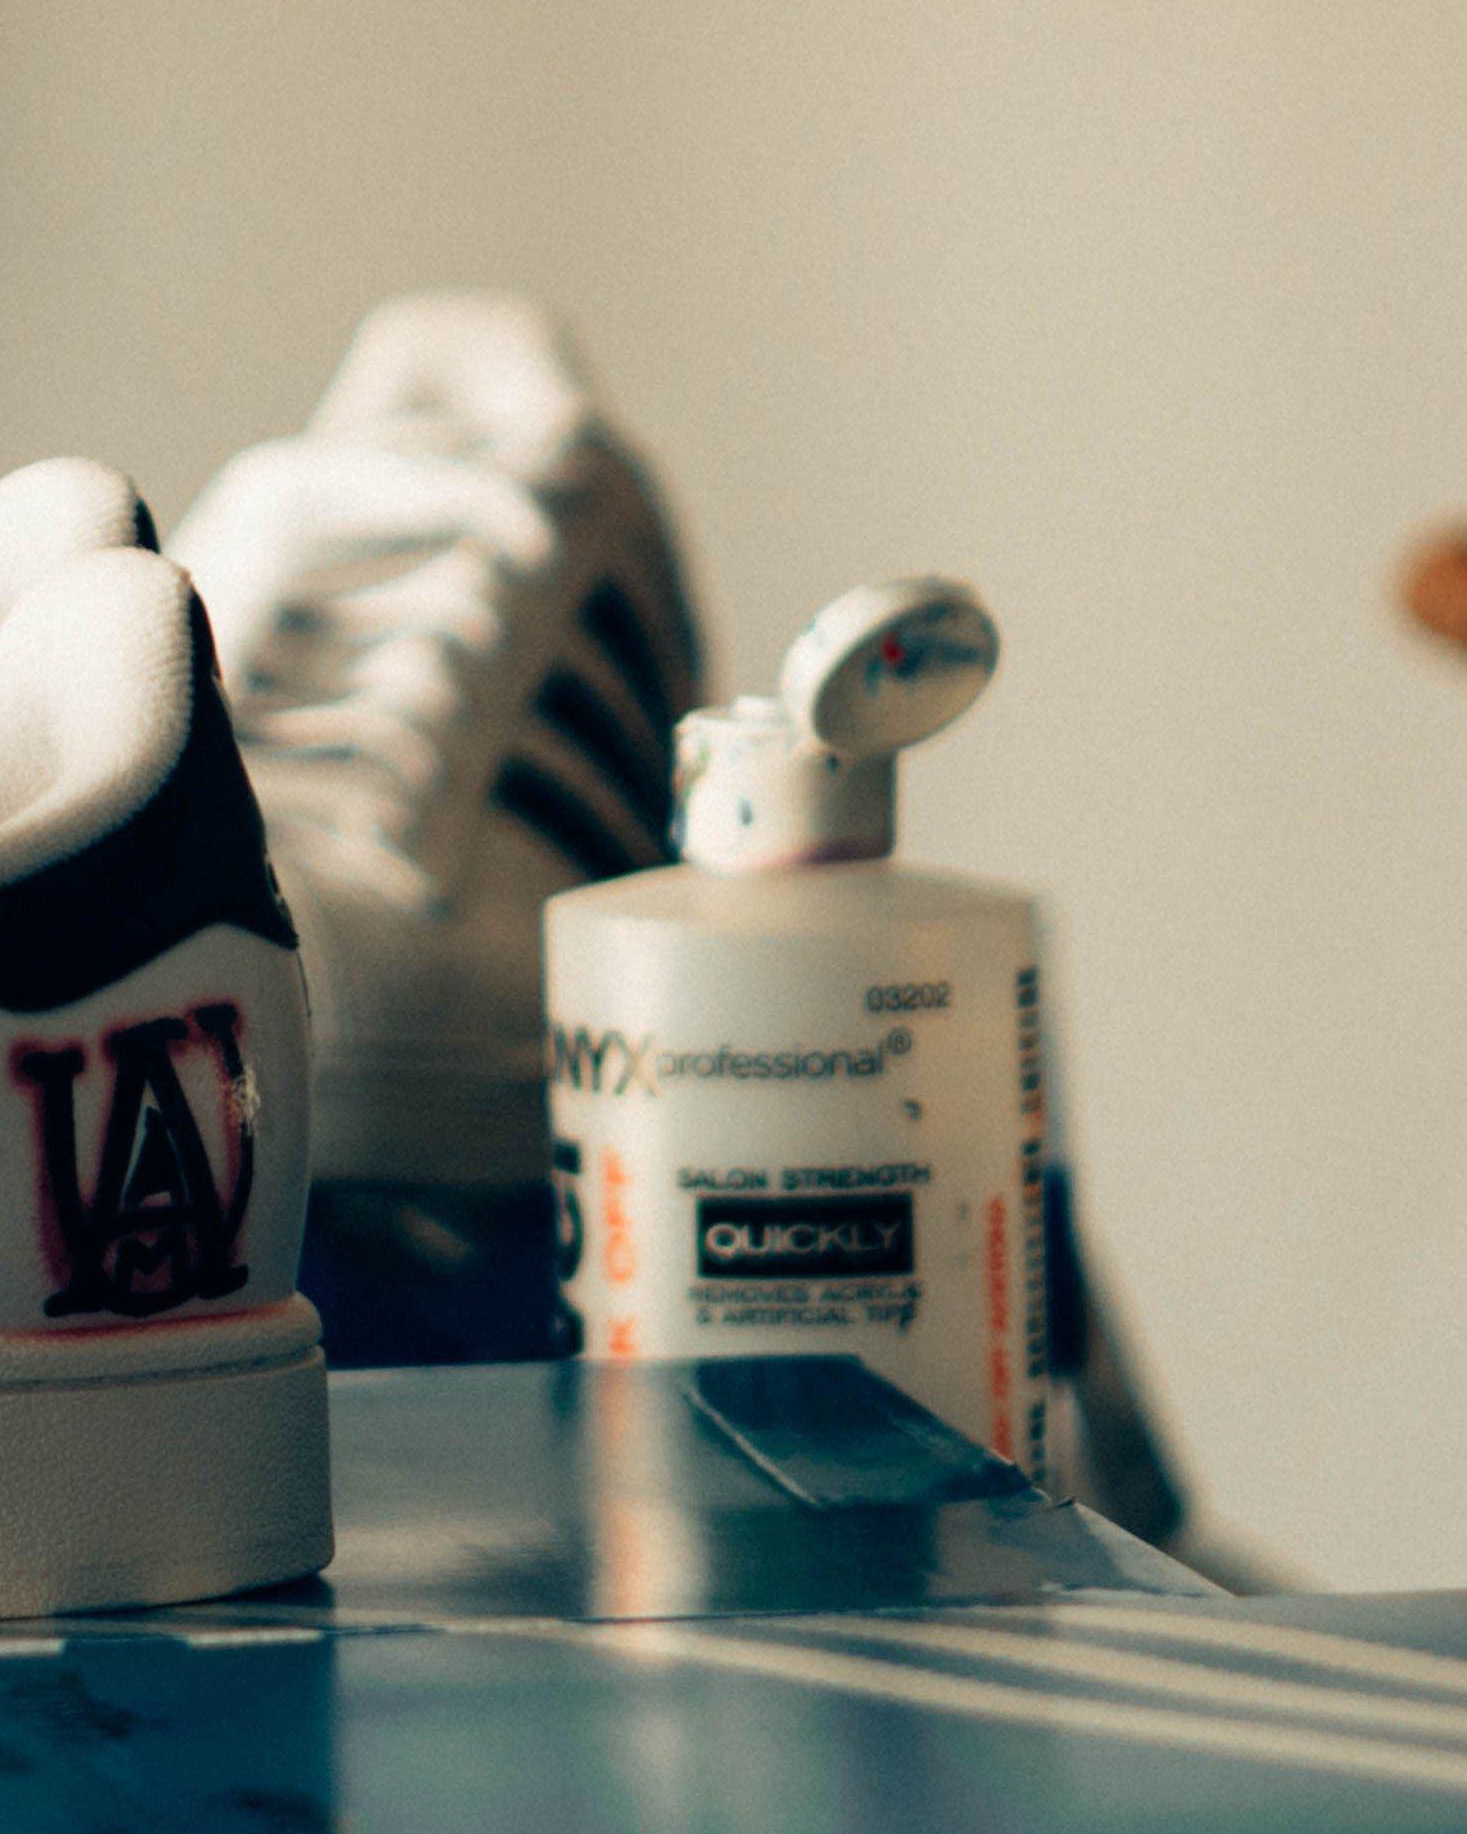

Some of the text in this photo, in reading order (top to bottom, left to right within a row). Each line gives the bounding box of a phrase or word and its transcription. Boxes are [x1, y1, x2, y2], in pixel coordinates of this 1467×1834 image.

[865, 982, 950, 1012] 03202
[678, 1163, 932, 1190] SALON STRENGTH
[705, 1221, 902, 1258] QUICKLY
